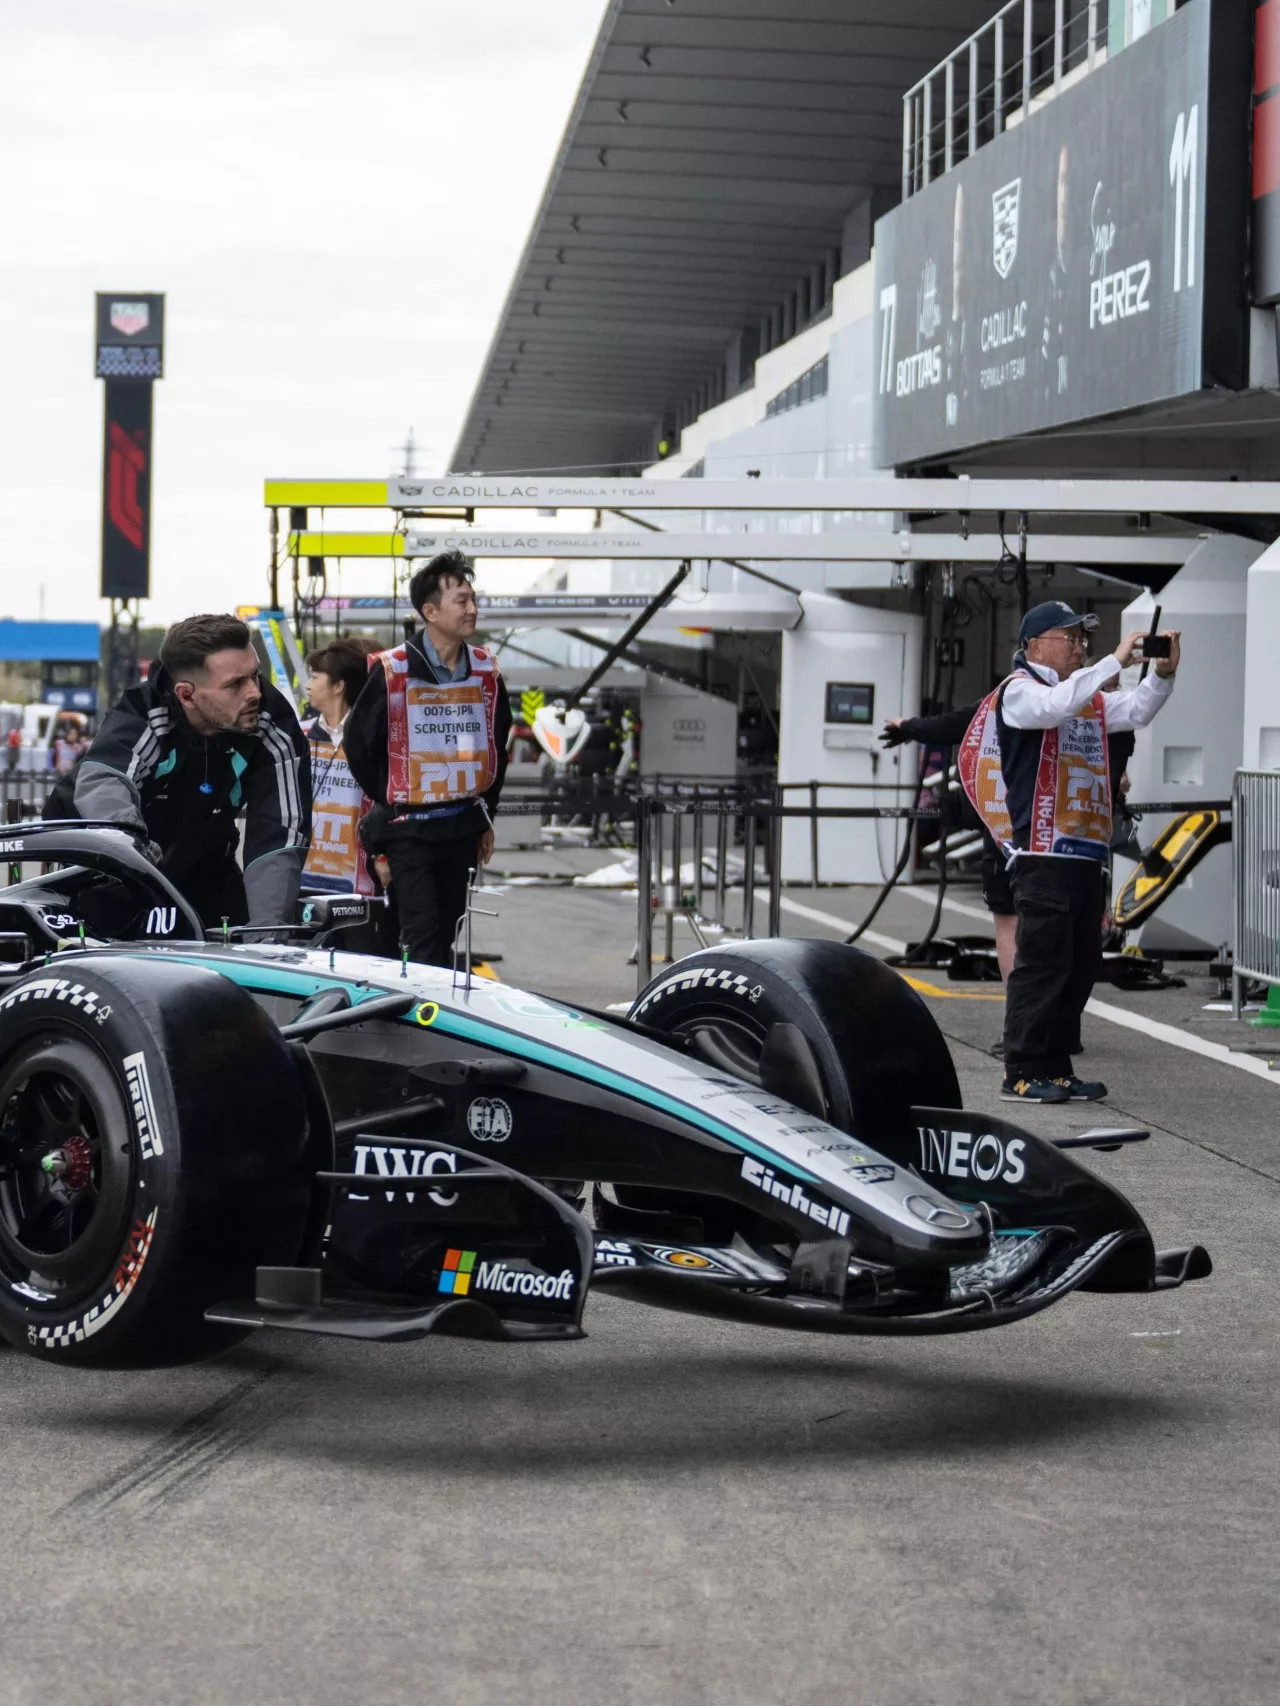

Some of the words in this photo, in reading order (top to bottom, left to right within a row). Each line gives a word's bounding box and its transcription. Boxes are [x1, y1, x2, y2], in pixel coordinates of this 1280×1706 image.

[1170, 104, 1199, 292] 11
[1089, 260, 1151, 329] PEREZ
[879, 284, 898, 395] 77
[980, 301, 1027, 352] CADILLAC
[896, 345, 942, 397] BOTTAS
[432, 486, 539, 497] CADILLAC
[548, 488, 607, 496] FORMULA
[622, 488, 655, 496] TEAM
[444, 537, 539, 548] CADILLAC
[547, 539, 598, 547] FORMULA
[611, 540, 642, 548] TEAM
[415, 722, 481, 735] SCRUTINEER
[445, 735, 458, 745] F1
[1035, 795, 1054, 853] JAPAN
[332, 906, 365, 917] PETRONAS
[123, 1051, 164, 1160] PIRELLI
[470, 1106, 509, 1133] FIA
[348, 1145, 459, 1207] IWC
[917, 1127, 1026, 1184] INEOS
[741, 1155, 851, 1237] Einhell
[476, 1261, 575, 1300] Microsoft
